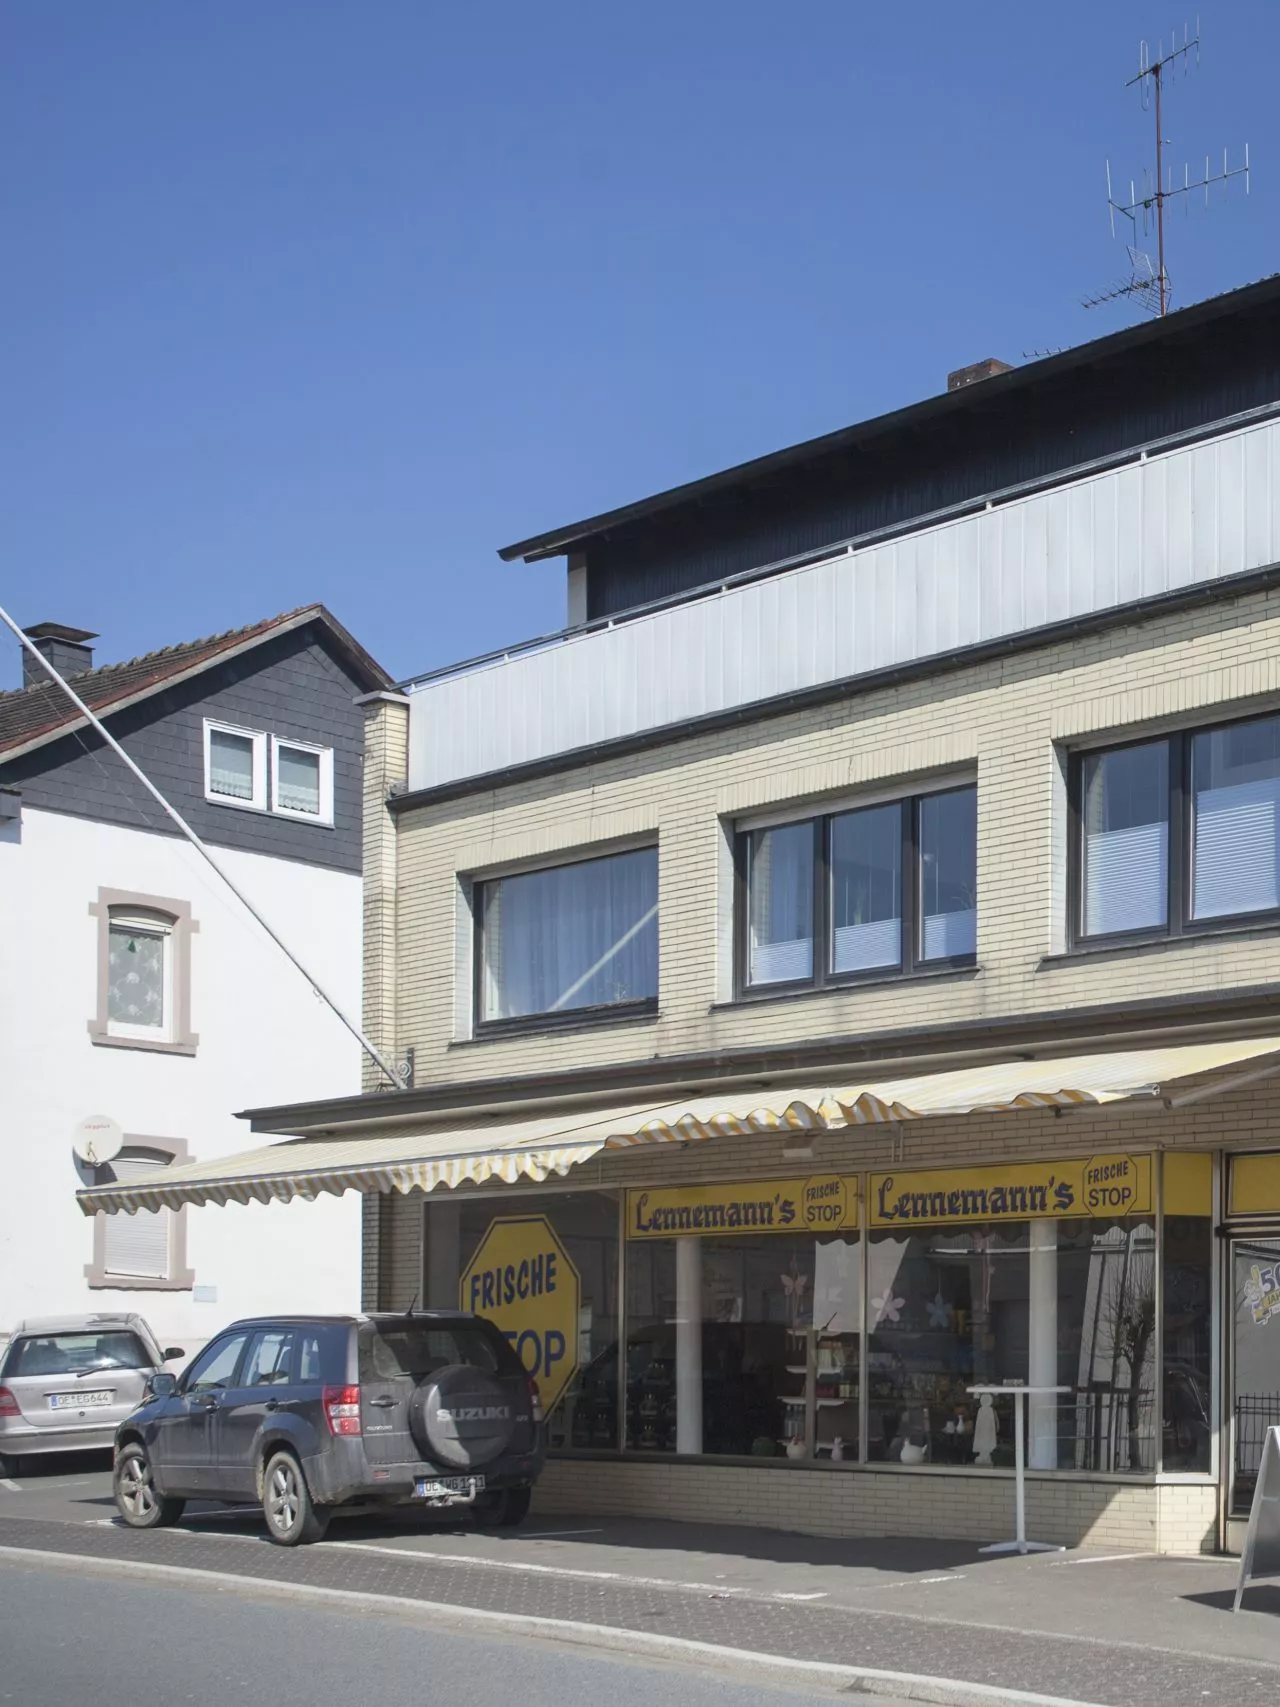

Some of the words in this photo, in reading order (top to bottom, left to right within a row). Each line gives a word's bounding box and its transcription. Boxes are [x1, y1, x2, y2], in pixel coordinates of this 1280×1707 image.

[1087, 1160, 1129, 1185] FRISCHE
[806, 1180, 840, 1202] FRISCHE
[878, 1176, 1075, 1220] Lennemann's
[1088, 1187, 1132, 1207] STOP
[635, 1193, 796, 1232] Lennemann's
[806, 1204, 842, 1223] STOP
[471, 1252, 557, 1312] FRISCHE
[500, 1329, 566, 1378] OP
[436, 1406, 510, 1422] SUZUKI
